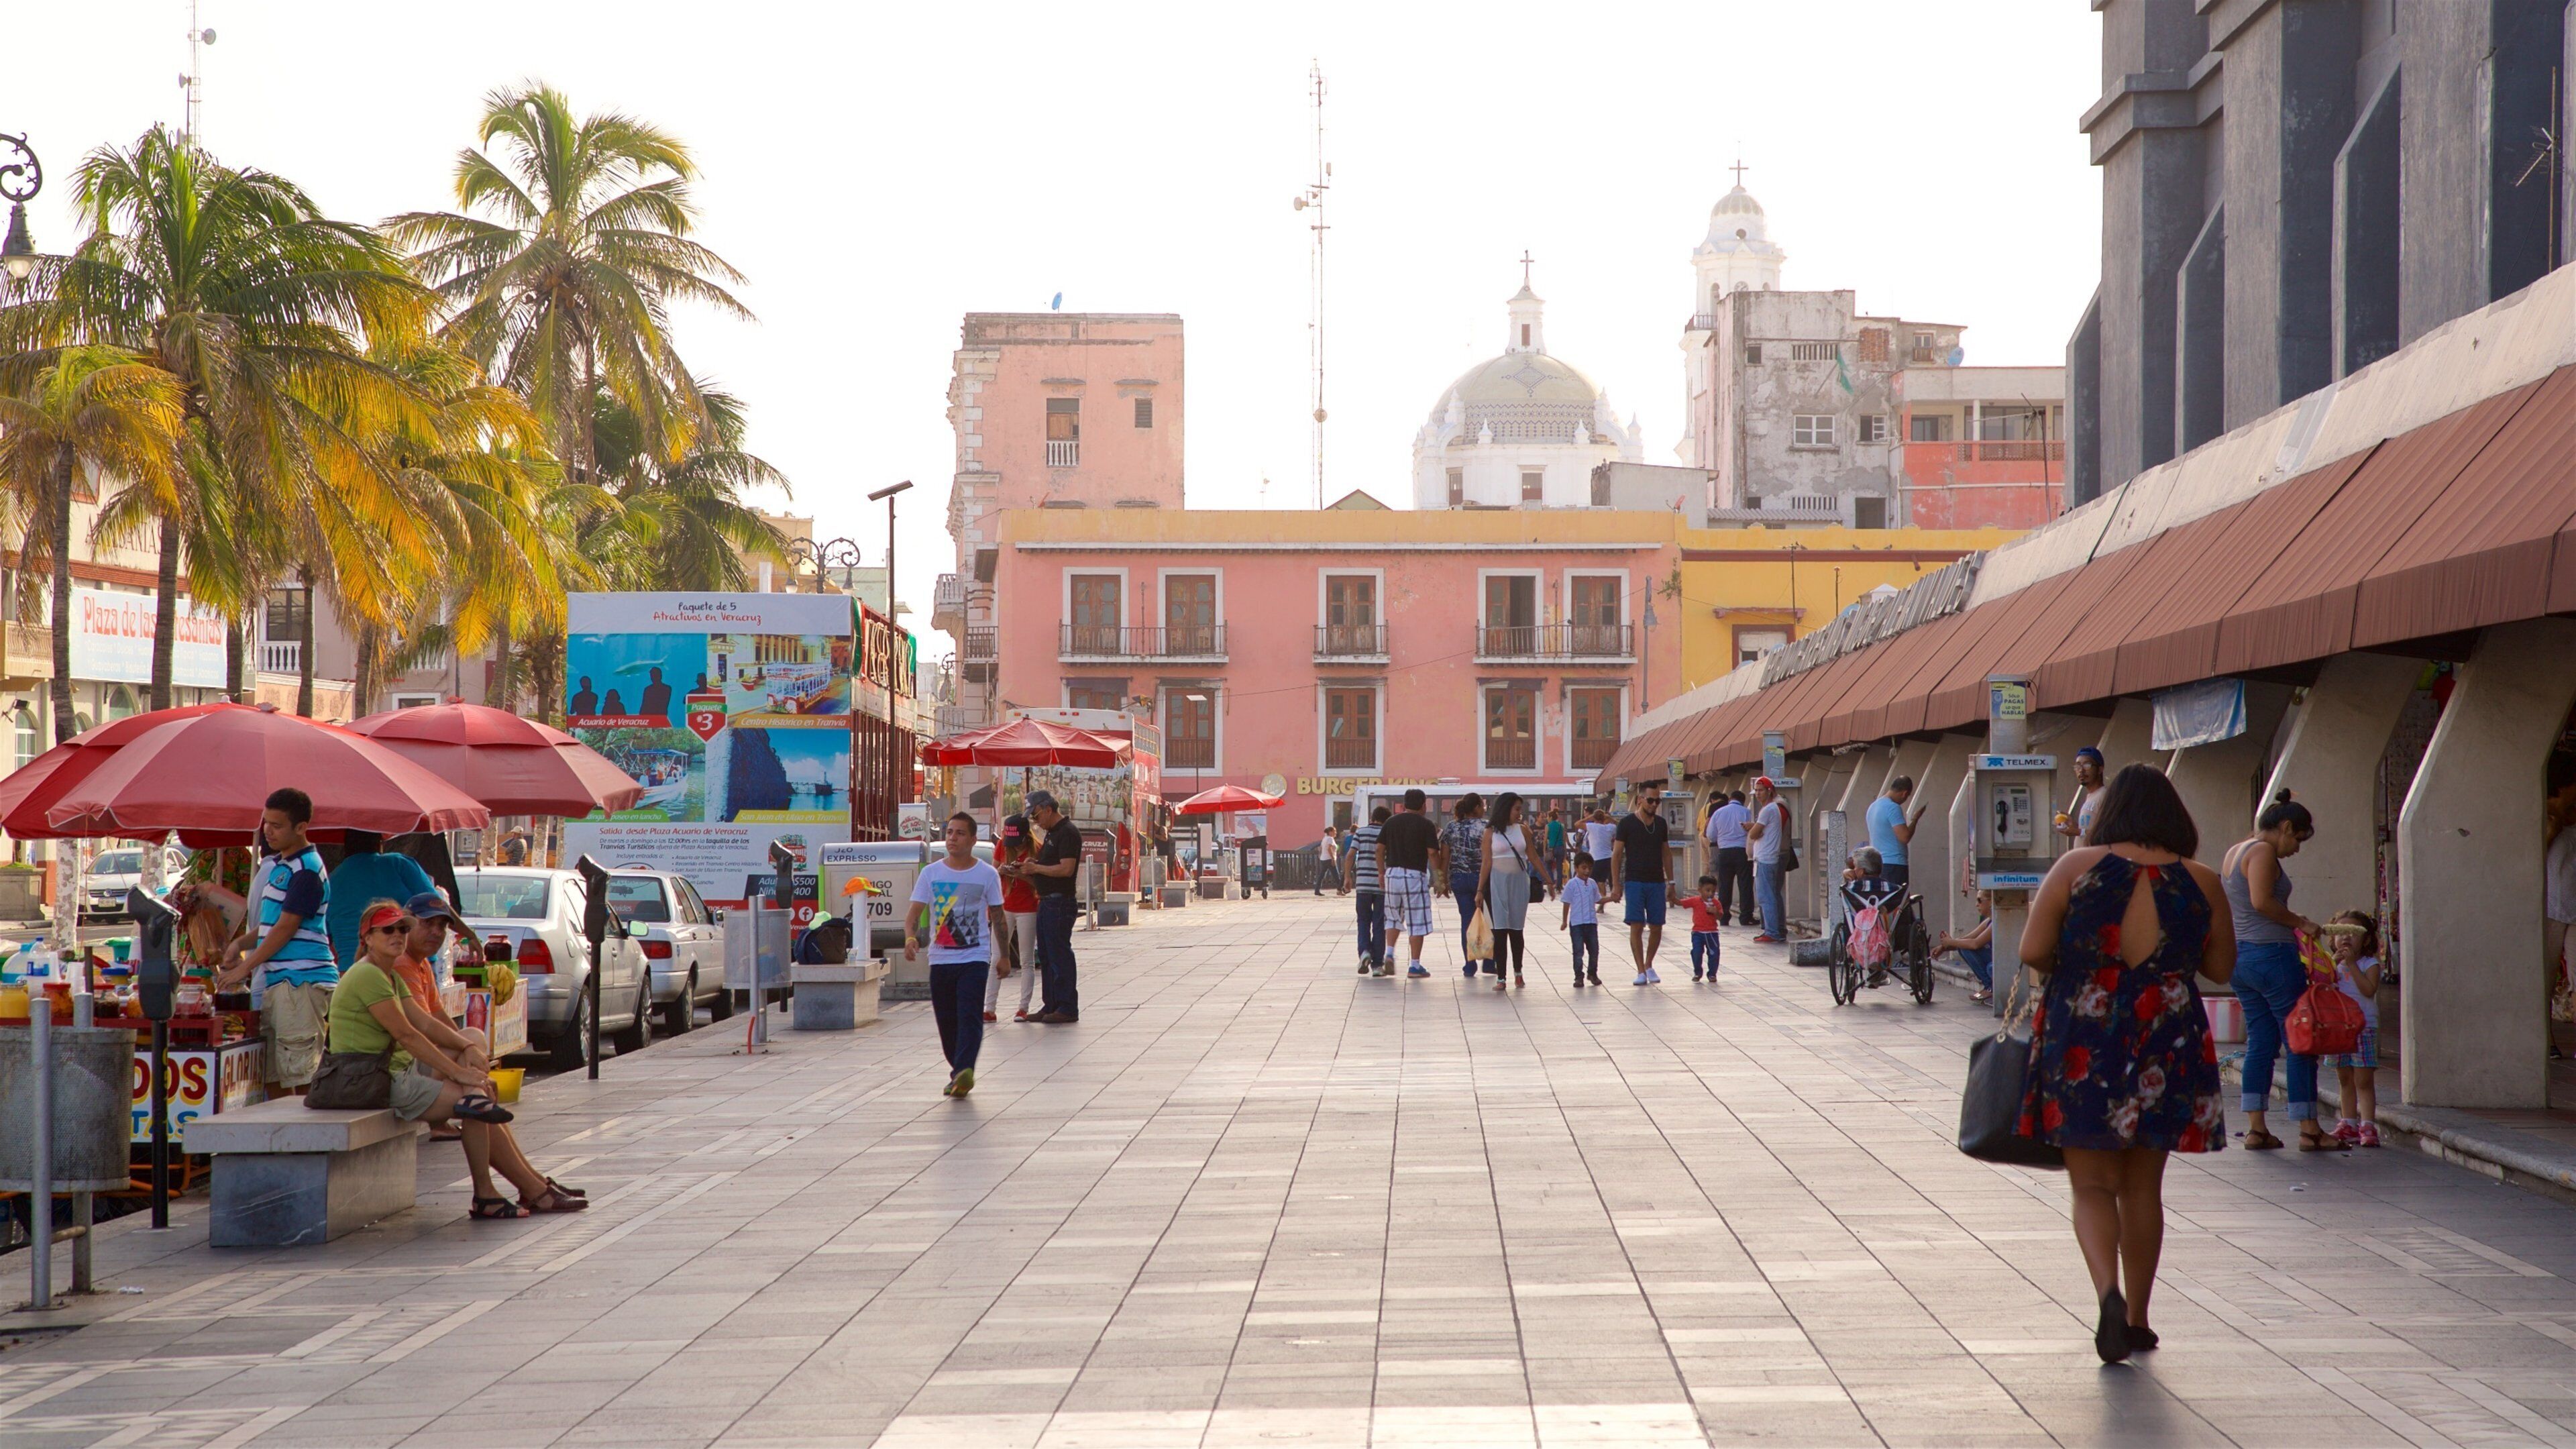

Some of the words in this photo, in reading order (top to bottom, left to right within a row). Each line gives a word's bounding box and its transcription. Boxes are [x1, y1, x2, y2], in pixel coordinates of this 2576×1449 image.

[678, 602, 713, 613] Paquete
[716, 602, 727, 611] de
[730, 602, 737, 611] 5
[84, 596, 118, 635] Plaza
[122, 601, 136, 637] de
[140, 602, 157, 639] las
[653, 612, 702, 622] Atractivos
[705, 614, 717, 622] en
[720, 612, 761, 626] Veracruz
[741, 718, 767, 726] Centro
[794, 877, 816, 885] $500
[1994, 875, 2039, 883] infinitum
[224, 1048, 264, 1092] GLORIAS
